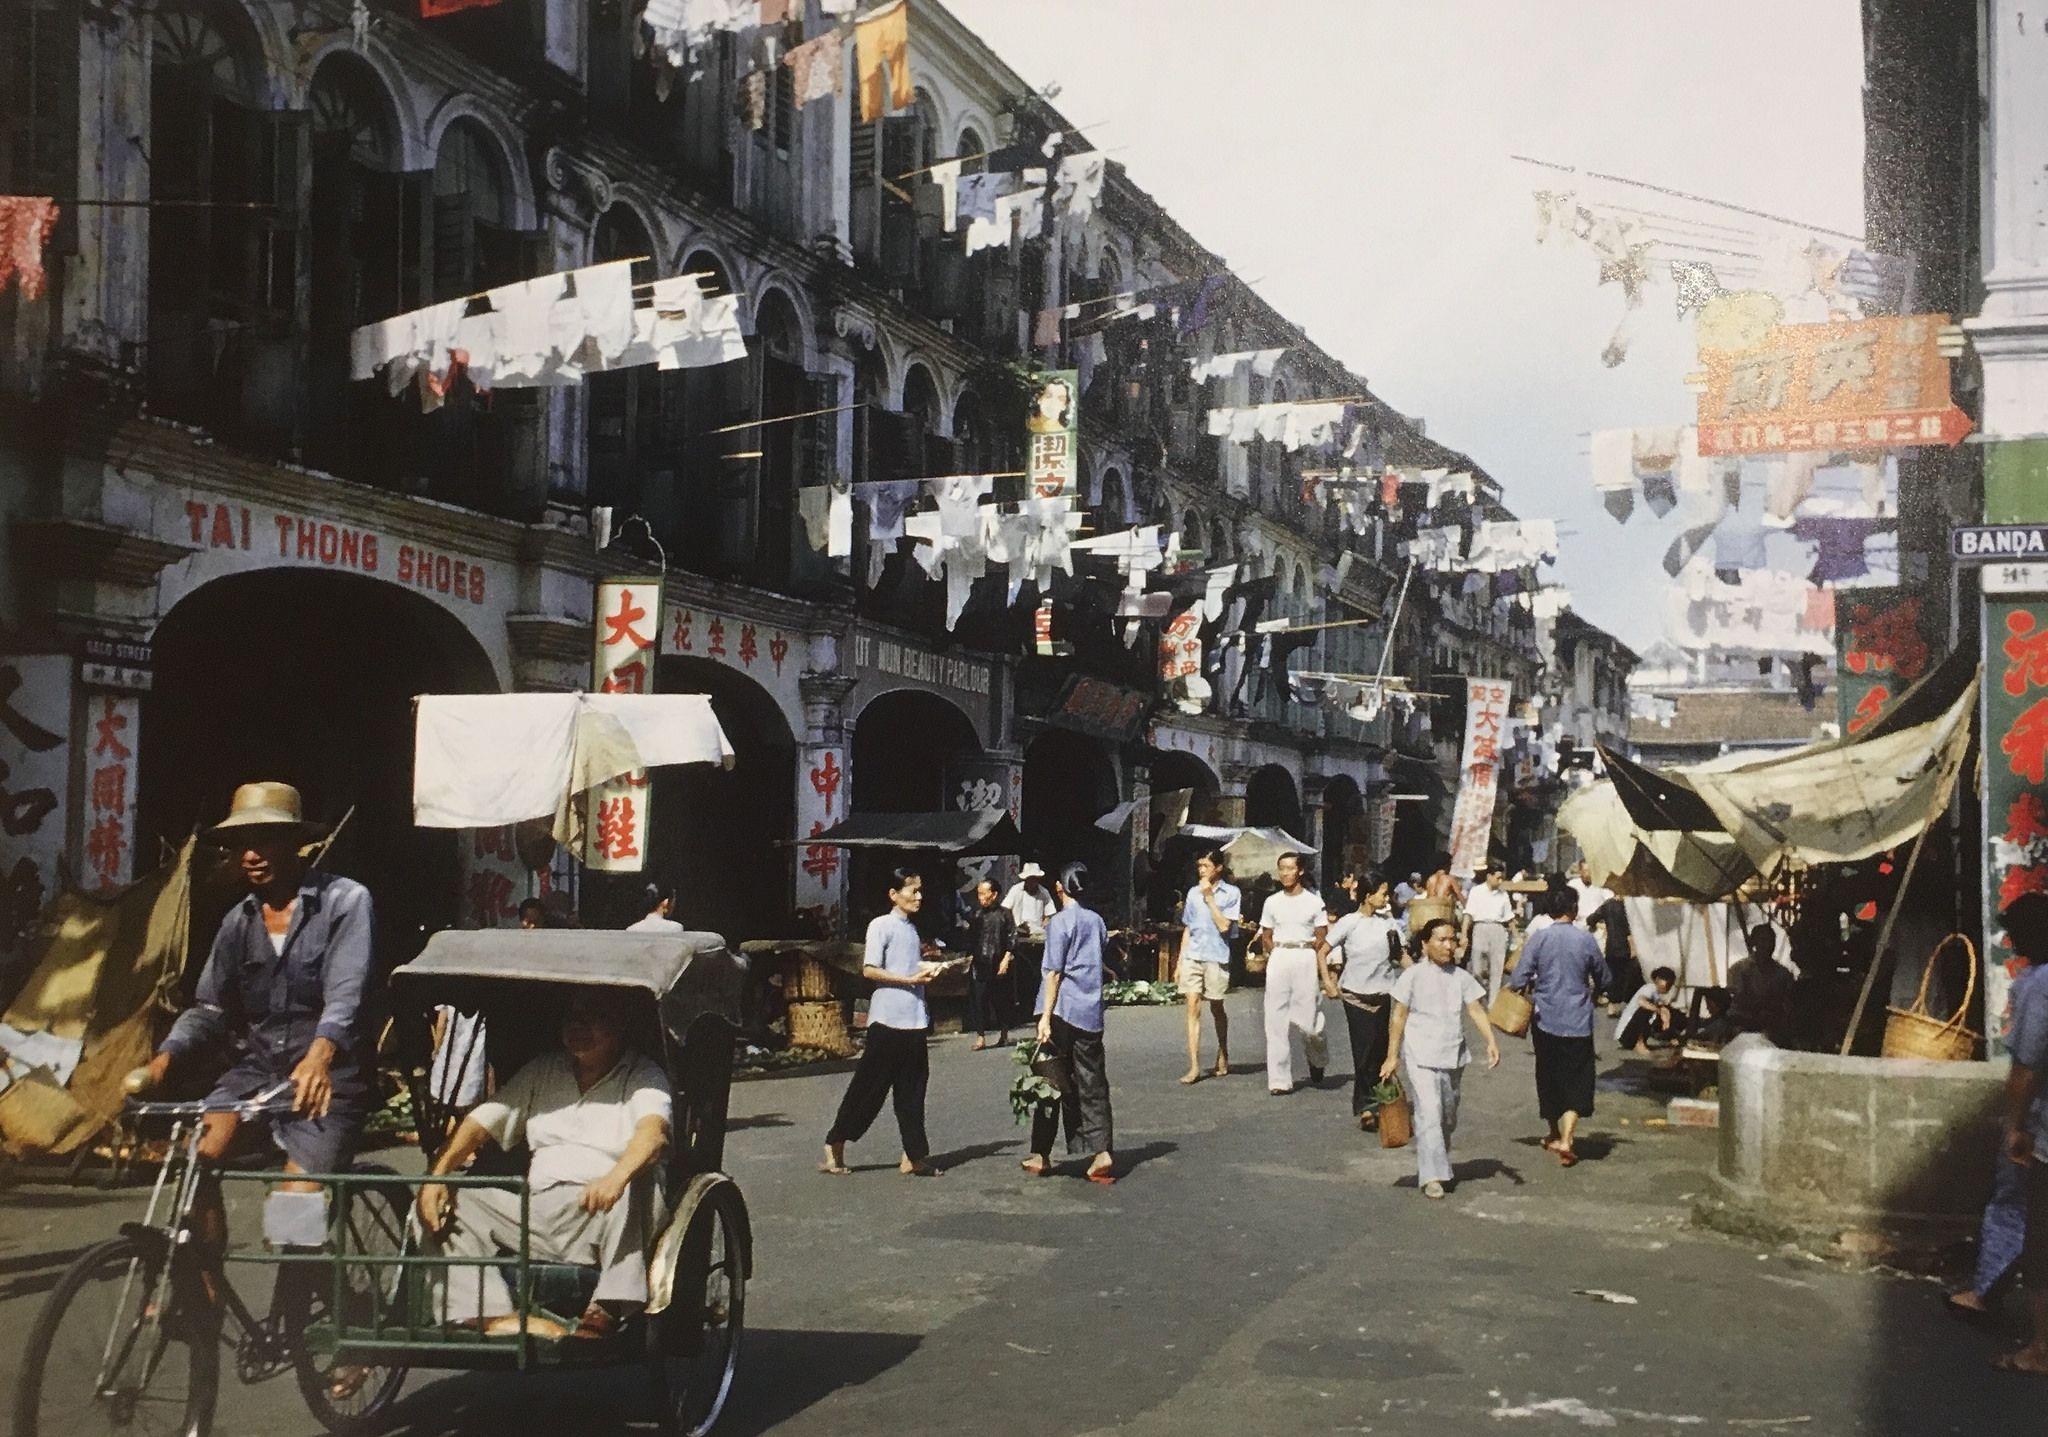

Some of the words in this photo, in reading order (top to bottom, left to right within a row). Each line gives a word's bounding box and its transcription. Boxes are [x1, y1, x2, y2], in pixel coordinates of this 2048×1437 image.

[185, 499, 251, 551] TAI
[274, 514, 379, 572] THONG
[398, 543, 486, 606] SHOES
[1961, 530, 2045, 555] BANDA
